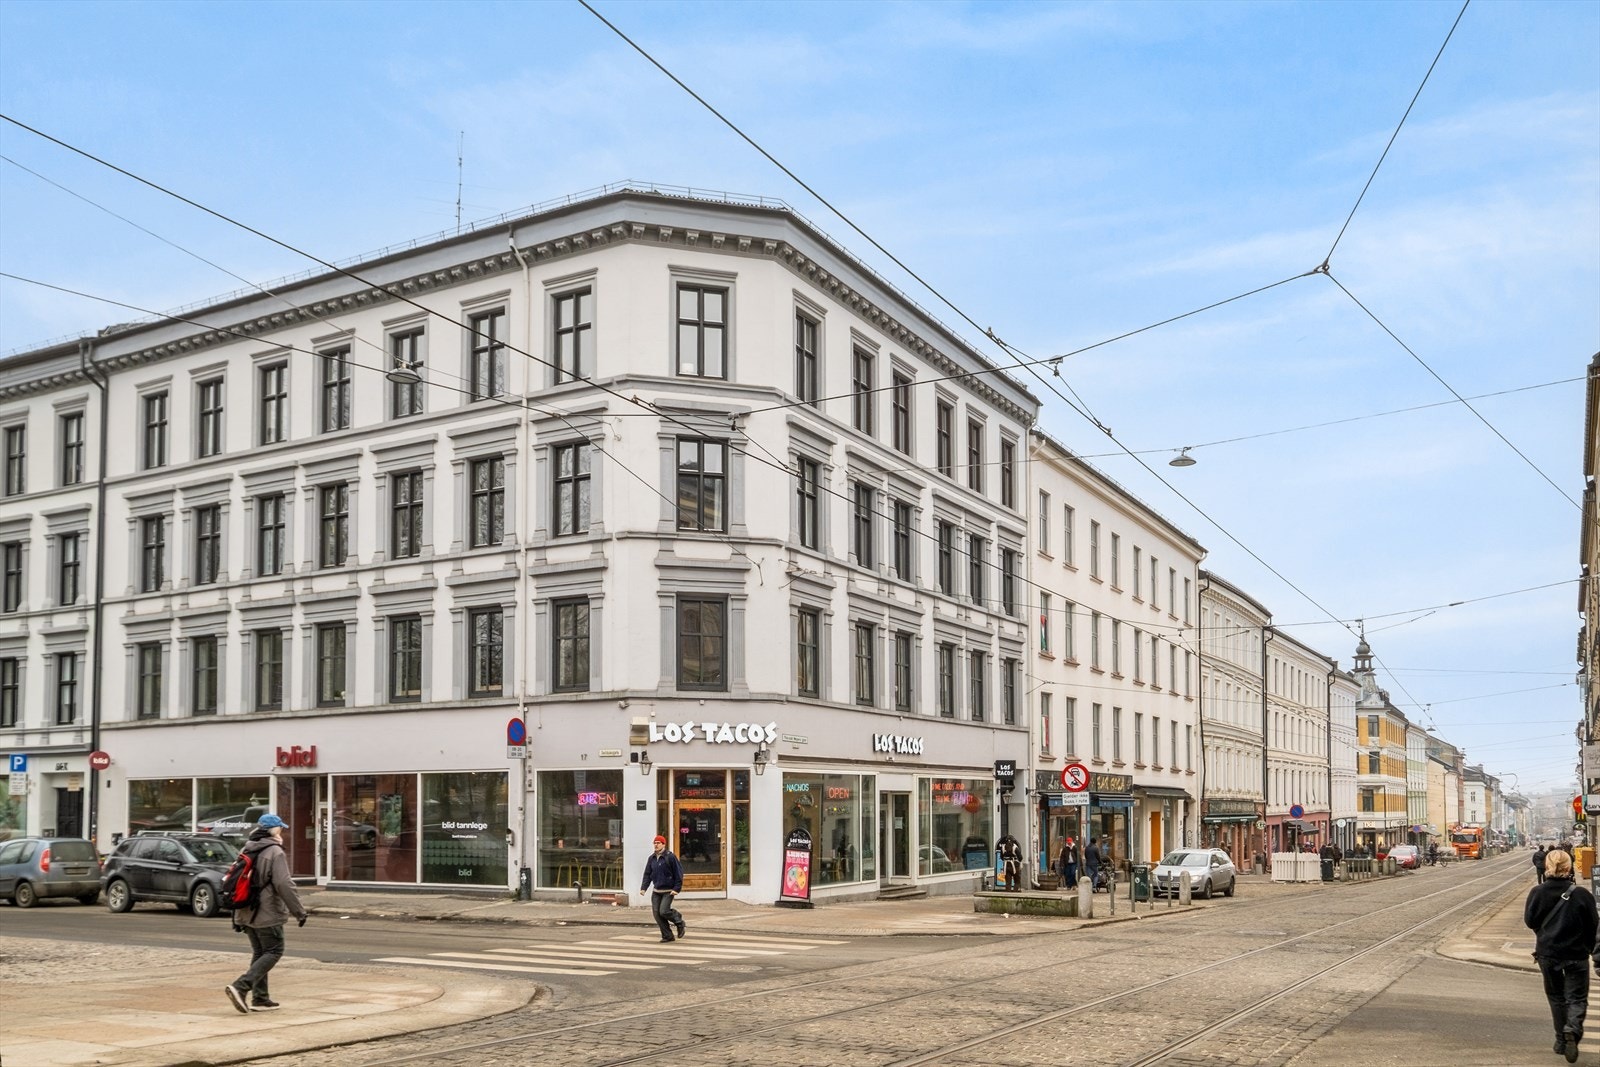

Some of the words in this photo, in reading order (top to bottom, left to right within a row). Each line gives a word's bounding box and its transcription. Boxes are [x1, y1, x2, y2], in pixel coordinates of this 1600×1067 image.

[649, 721, 696, 744] LOS
[701, 721, 778, 744] TACOS
[873, 733, 894, 753] LOS
[893, 735, 924, 755] TACOS
[276, 745, 317, 767] blid
[13, 756, 24, 770] P
[786, 783, 810, 792] NACHOS
[828, 787, 850, 799] OPEN
[441, 821, 456, 829] blid
[456, 821, 488, 831] tannlege
[458, 869, 473, 877] blid
